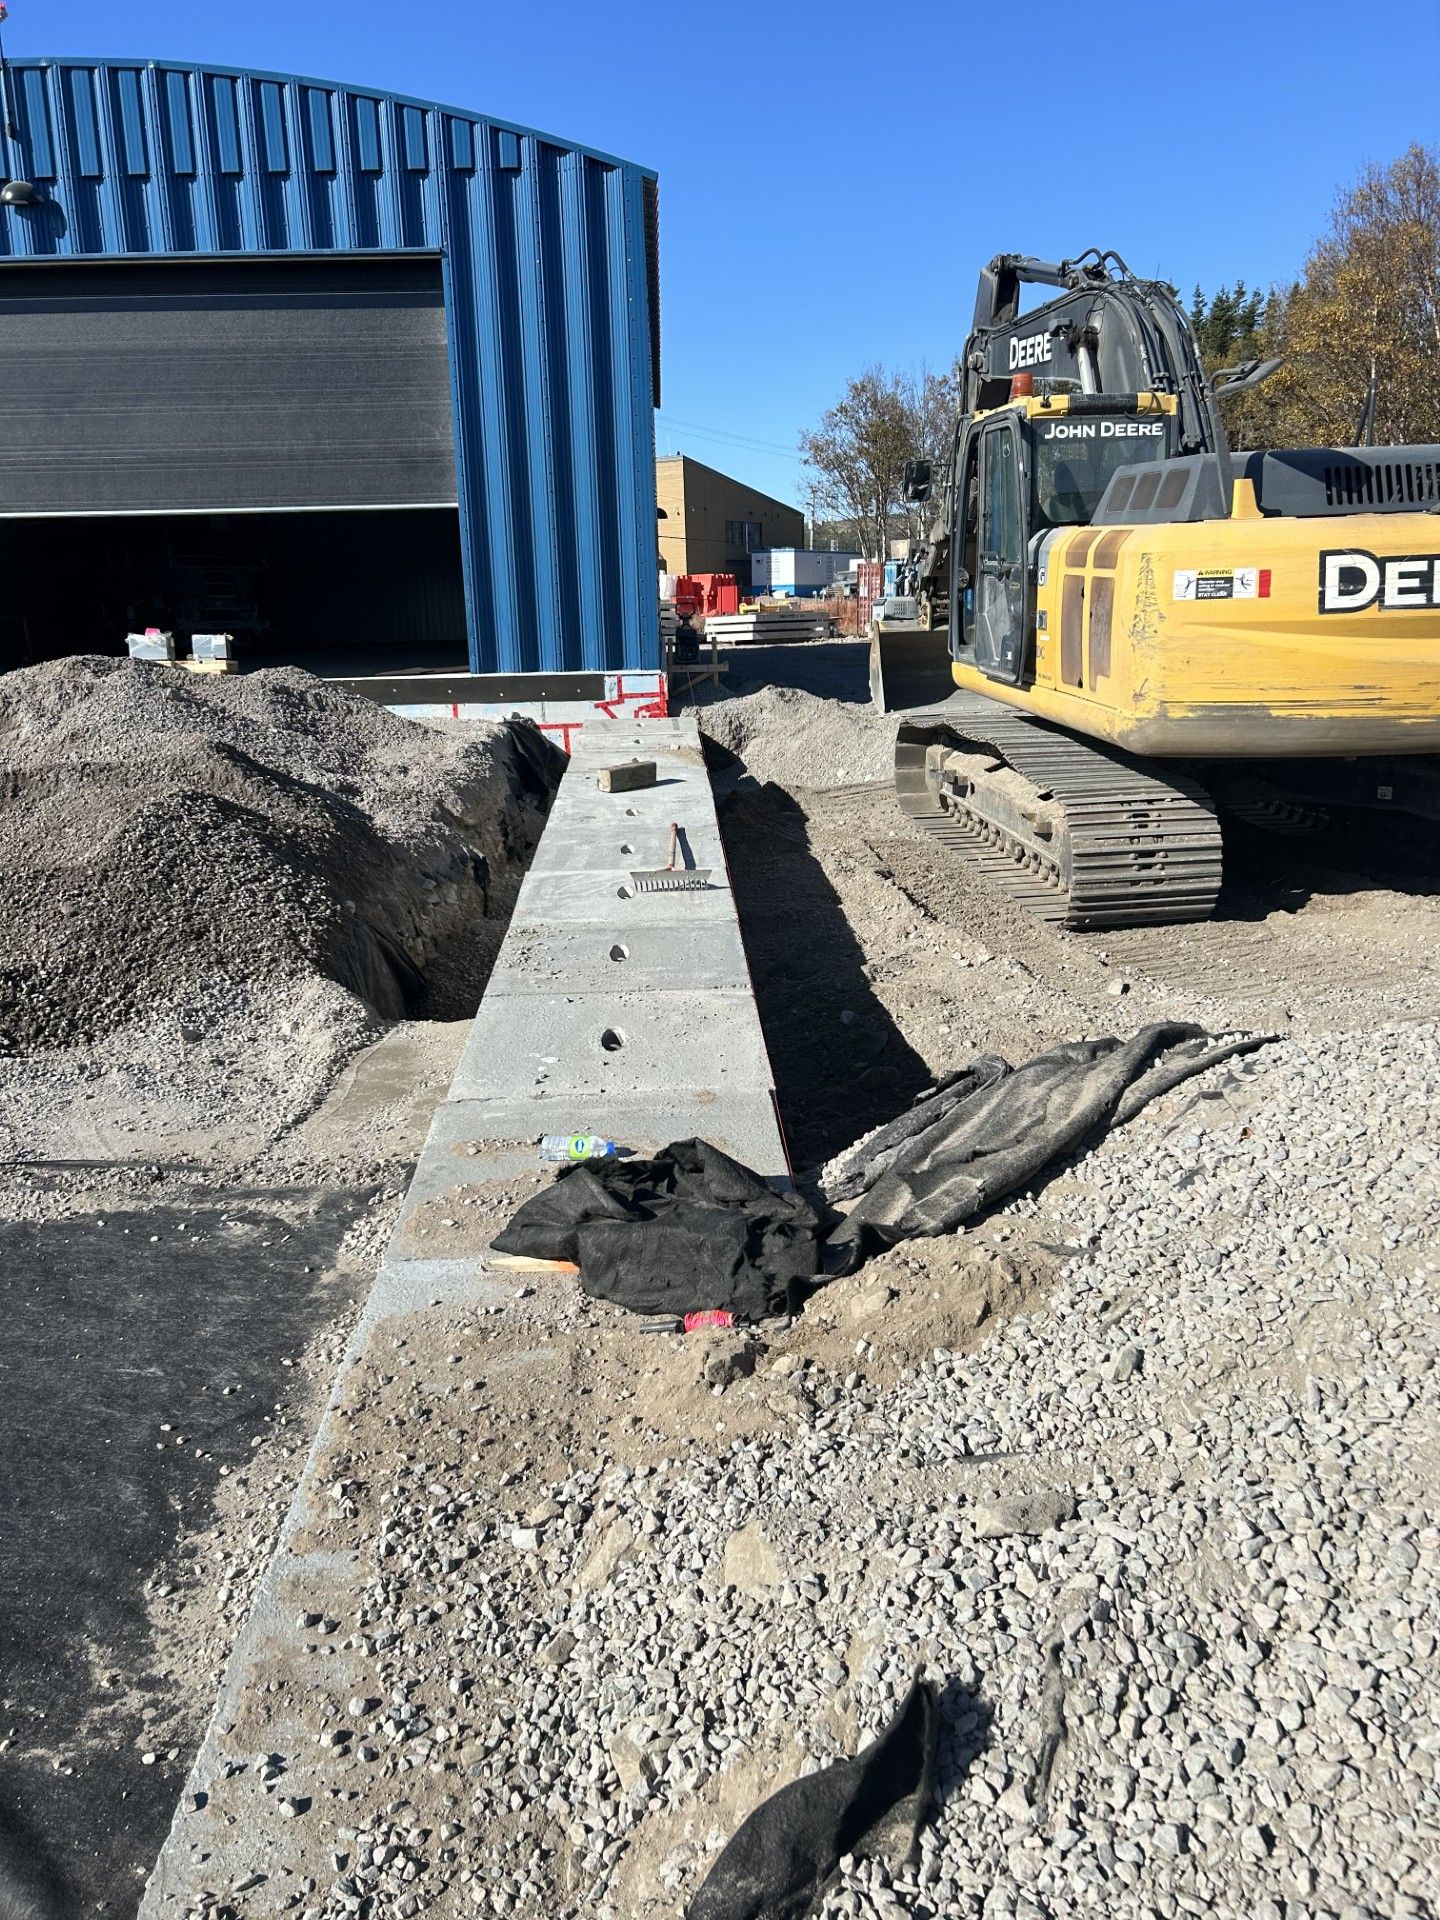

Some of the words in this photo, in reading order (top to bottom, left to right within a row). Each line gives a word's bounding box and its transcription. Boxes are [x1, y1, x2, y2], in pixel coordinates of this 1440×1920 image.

[1009, 331, 1052, 370] DEERE
[1044, 423, 1096, 440] JOHN
[1100, 421, 1163, 438] DEERE
[1324, 554, 1440, 610] DE
